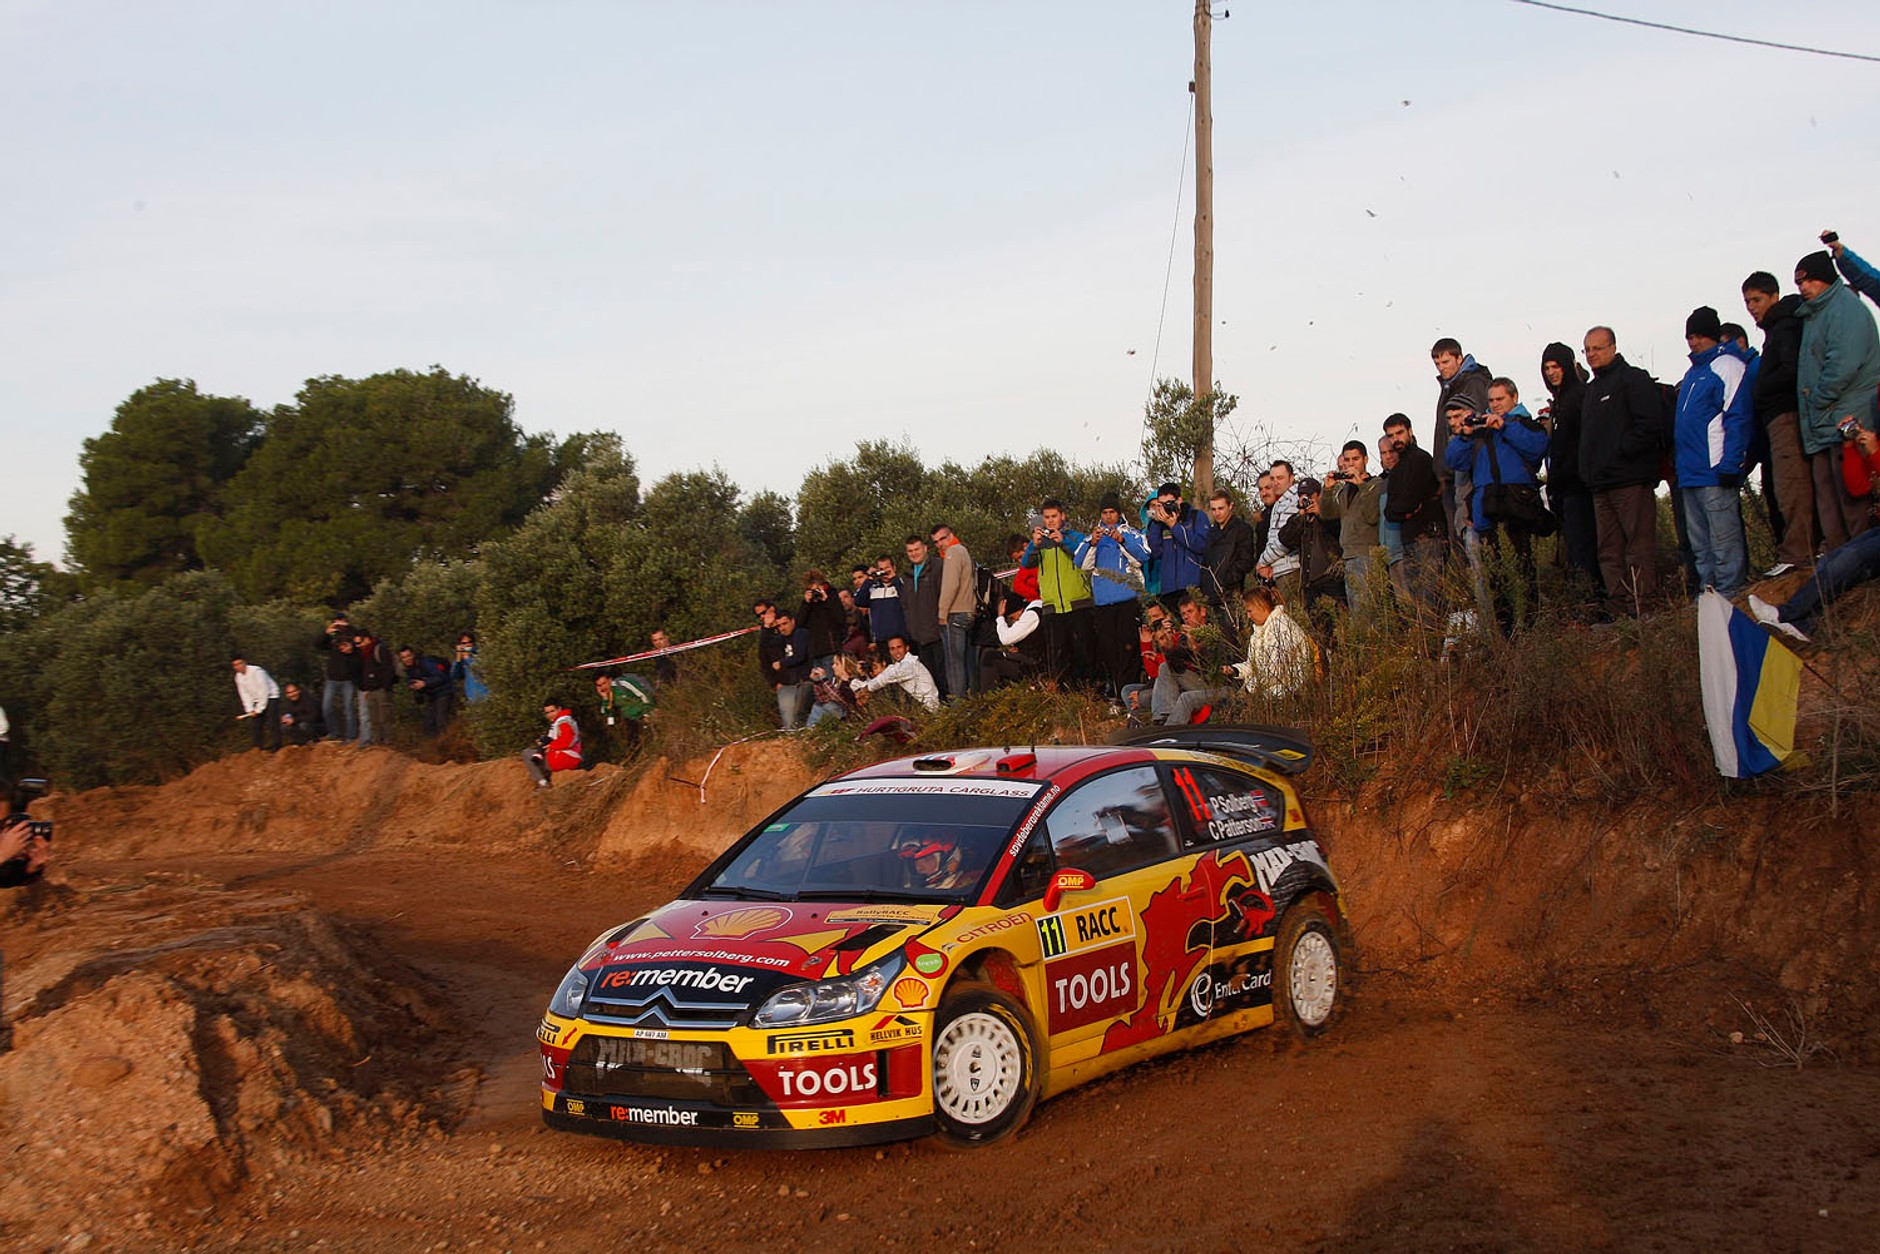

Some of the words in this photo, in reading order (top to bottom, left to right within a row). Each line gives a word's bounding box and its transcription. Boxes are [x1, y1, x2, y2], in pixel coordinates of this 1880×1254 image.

[856, 785, 944, 794] HURTIGRUTA
[949, 786, 1031, 797] CARGLASS
[1173, 766, 1213, 821] 11
[1209, 796, 1221, 815] P
[1219, 793, 1259, 815] Solberg
[1208, 820, 1219, 841] C
[1217, 816, 1262, 840] Patterson
[1058, 875, 1084, 887] OMP
[1076, 906, 1122, 942] RACC
[1041, 916, 1064, 956] 11
[613, 950, 790, 967] www.pettersolberg.com
[600, 967, 755, 994] re:member
[1055, 962, 1131, 1014] TOOLS
[1215, 969, 1273, 999] EntCard
[767, 1029, 854, 1055] PIRELLI
[870, 1028, 902, 1041] HELLVIK
[904, 1026, 922, 1036] HUS
[778, 1063, 878, 1095] TOOLS
[566, 1101, 585, 1113] OMP
[610, 1105, 698, 1126] re:member
[819, 1109, 846, 1125] 3M
[733, 1114, 759, 1126] OMP
